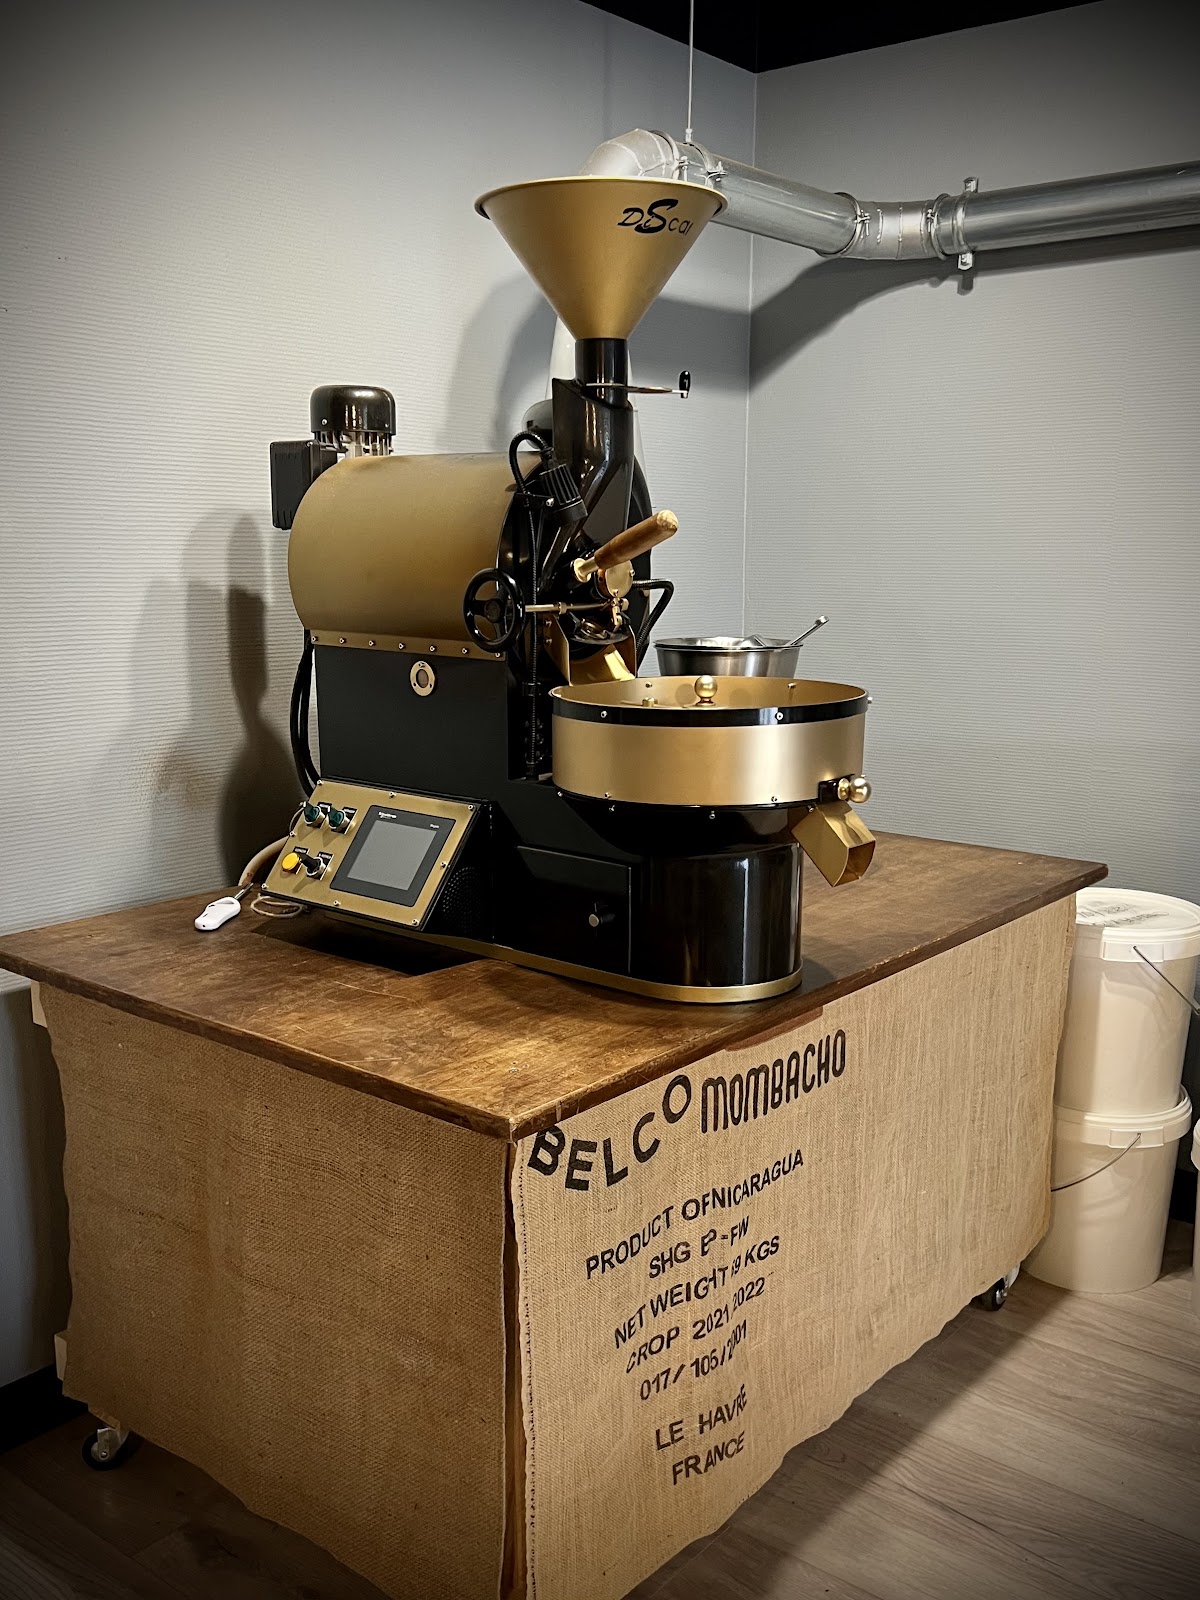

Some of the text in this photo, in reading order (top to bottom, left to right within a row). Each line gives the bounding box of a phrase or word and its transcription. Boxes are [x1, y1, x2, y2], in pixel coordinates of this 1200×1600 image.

[527, 1029, 847, 1191] BELCO MOMBACHO
[585, 1205, 674, 1279] PRODUCT
[648, 1241, 691, 1279] SHG
[613, 1304, 646, 1348] NET
[649, 1266, 729, 1317] WEIGHT
[744, 1235, 780, 1268] KGS
[625, 1326, 680, 1374] CROP
[655, 1384, 748, 1450] LE HAVRE
[672, 1430, 746, 1486] FRANCE
